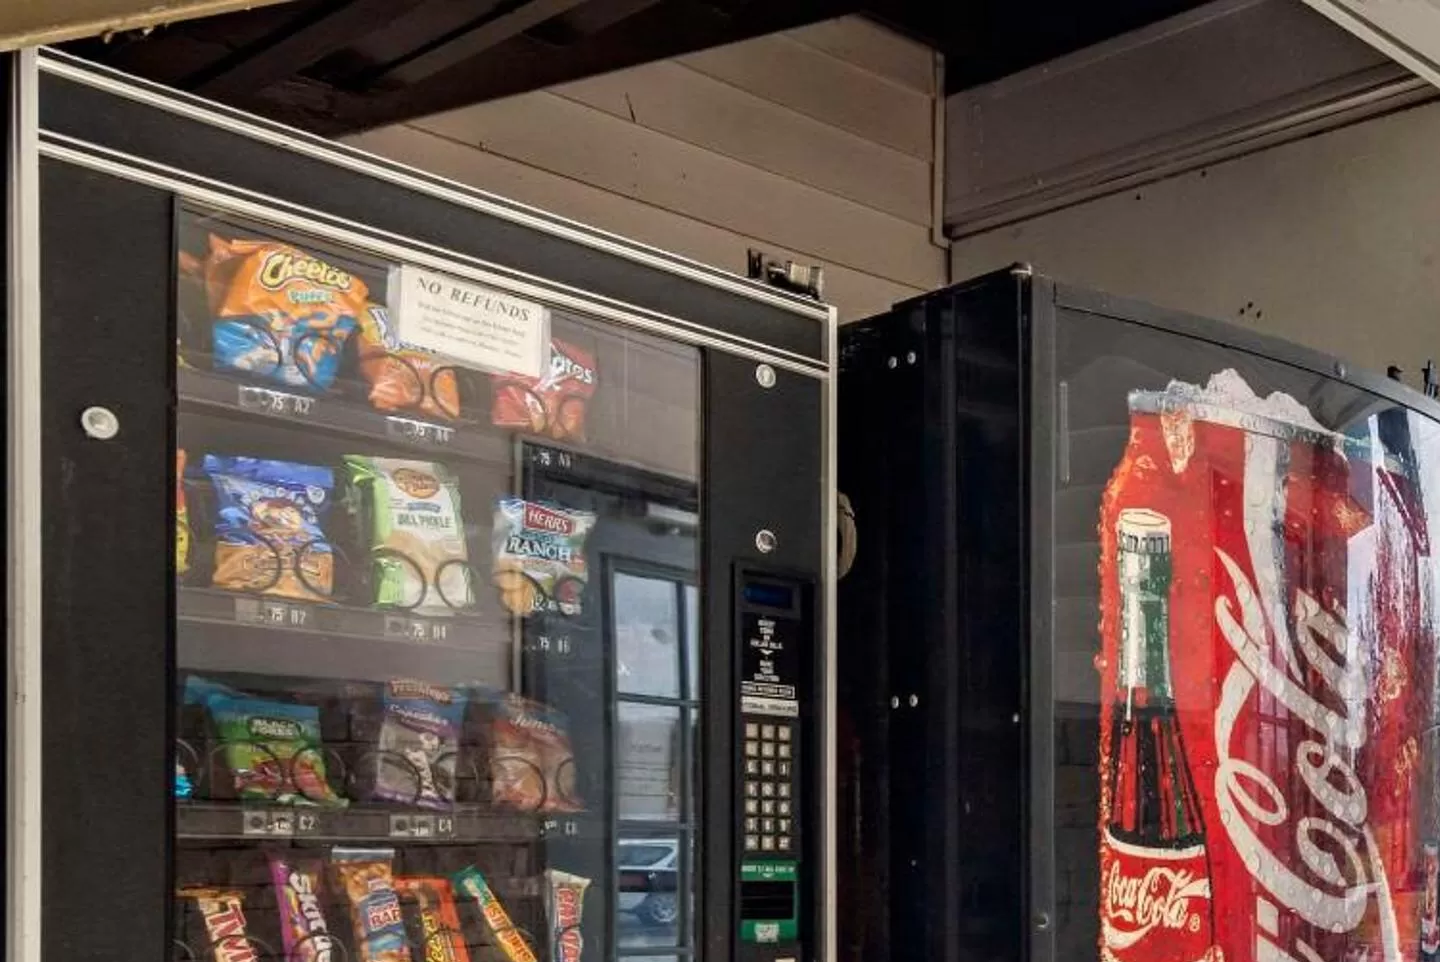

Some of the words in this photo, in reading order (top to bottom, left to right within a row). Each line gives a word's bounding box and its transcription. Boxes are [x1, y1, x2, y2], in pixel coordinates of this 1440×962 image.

[261, 251, 351, 289] Cheetos
[417, 276, 442, 295] NO
[450, 287, 531, 322] REFUNDS
[506, 536, 572, 561] RANCH
[1106, 859, 1190, 930] Coca-Cola
